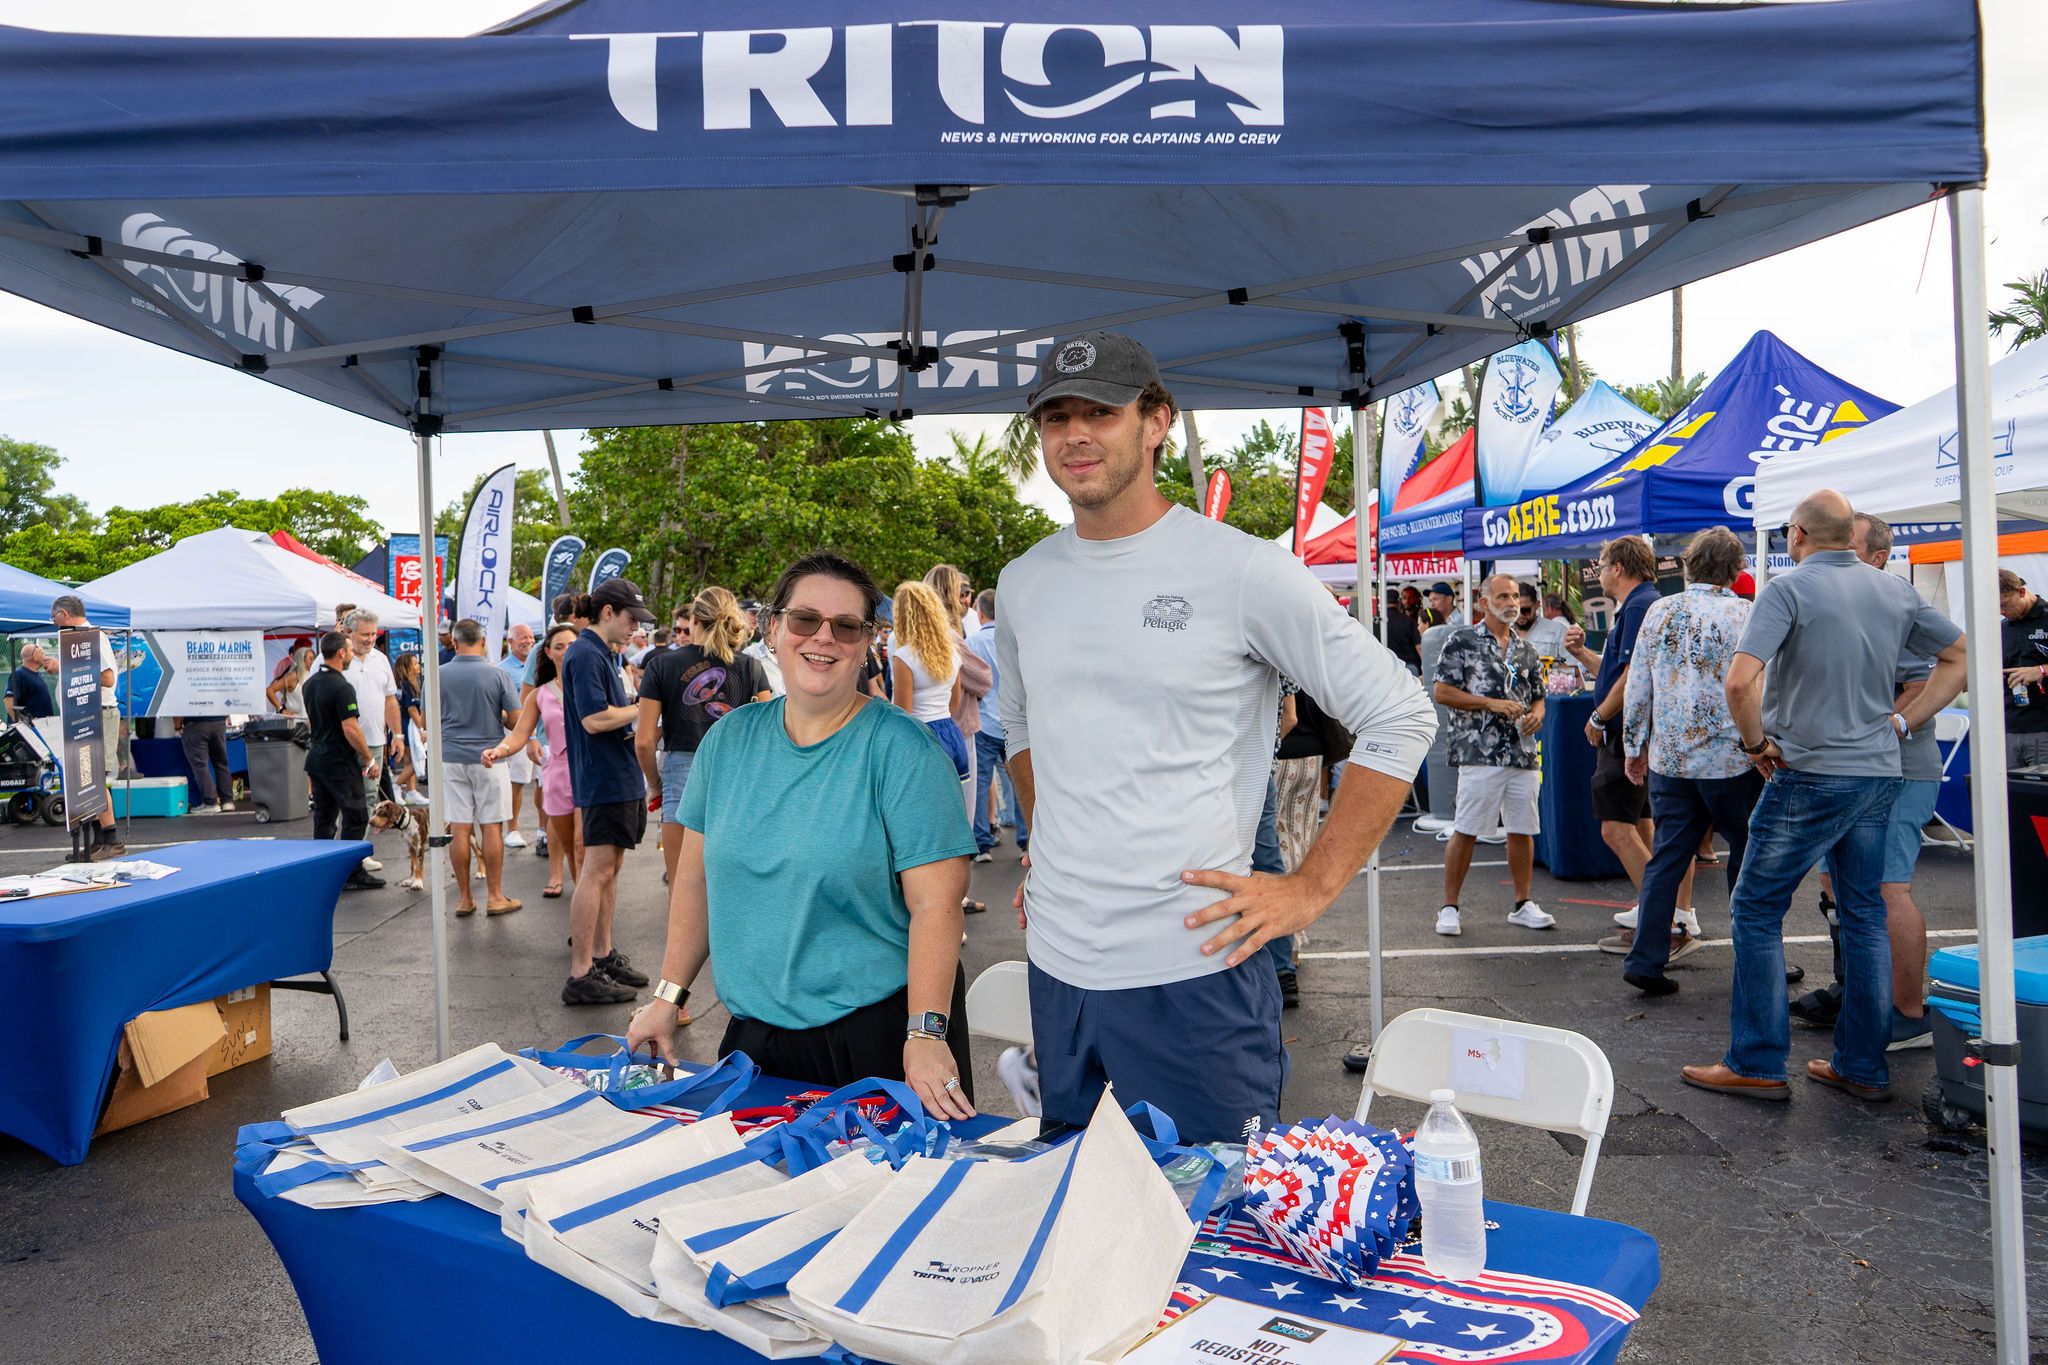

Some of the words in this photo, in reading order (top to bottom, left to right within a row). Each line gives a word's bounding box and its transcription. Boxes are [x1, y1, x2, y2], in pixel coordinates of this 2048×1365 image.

[569, 20, 1285, 131] TRITON
[940, 132, 984, 143] NEWS
[987, 132, 996, 143] &
[1000, 132, 1097, 144] NETWORKING
[1100, 132, 1129, 144] FOR
[1132, 132, 1201, 144] CAPTAINS
[1204, 133, 1235, 144] AND
[1238, 133, 1281, 145] CREW
[1496, 355, 1540, 374] BLUEWATER
[1493, 401, 1513, 422] YACHT
[1517, 408, 1540, 424] CANVAS
[1574, 420, 1658, 439] BLUEWAT
[1481, 494, 1616, 547] GoAERE.com
[477, 489, 503, 608] AIRLOCK
[1392, 557, 1458, 576] YAMAHA
[1143, 617, 1187, 632] Pelagic
[187, 641, 214, 654] BEARD
[218, 640, 252, 654] MARINE
[913, 1270, 956, 1283] TRITON
[952, 1262, 1000, 1273] ROPNER
[1268, 1325, 1309, 1340] EXPO
[1277, 1321, 1314, 1336] TRITON
[1190, 1339, 1302, 1365] REGISTER
[1247, 1338, 1290, 1356] NOT
